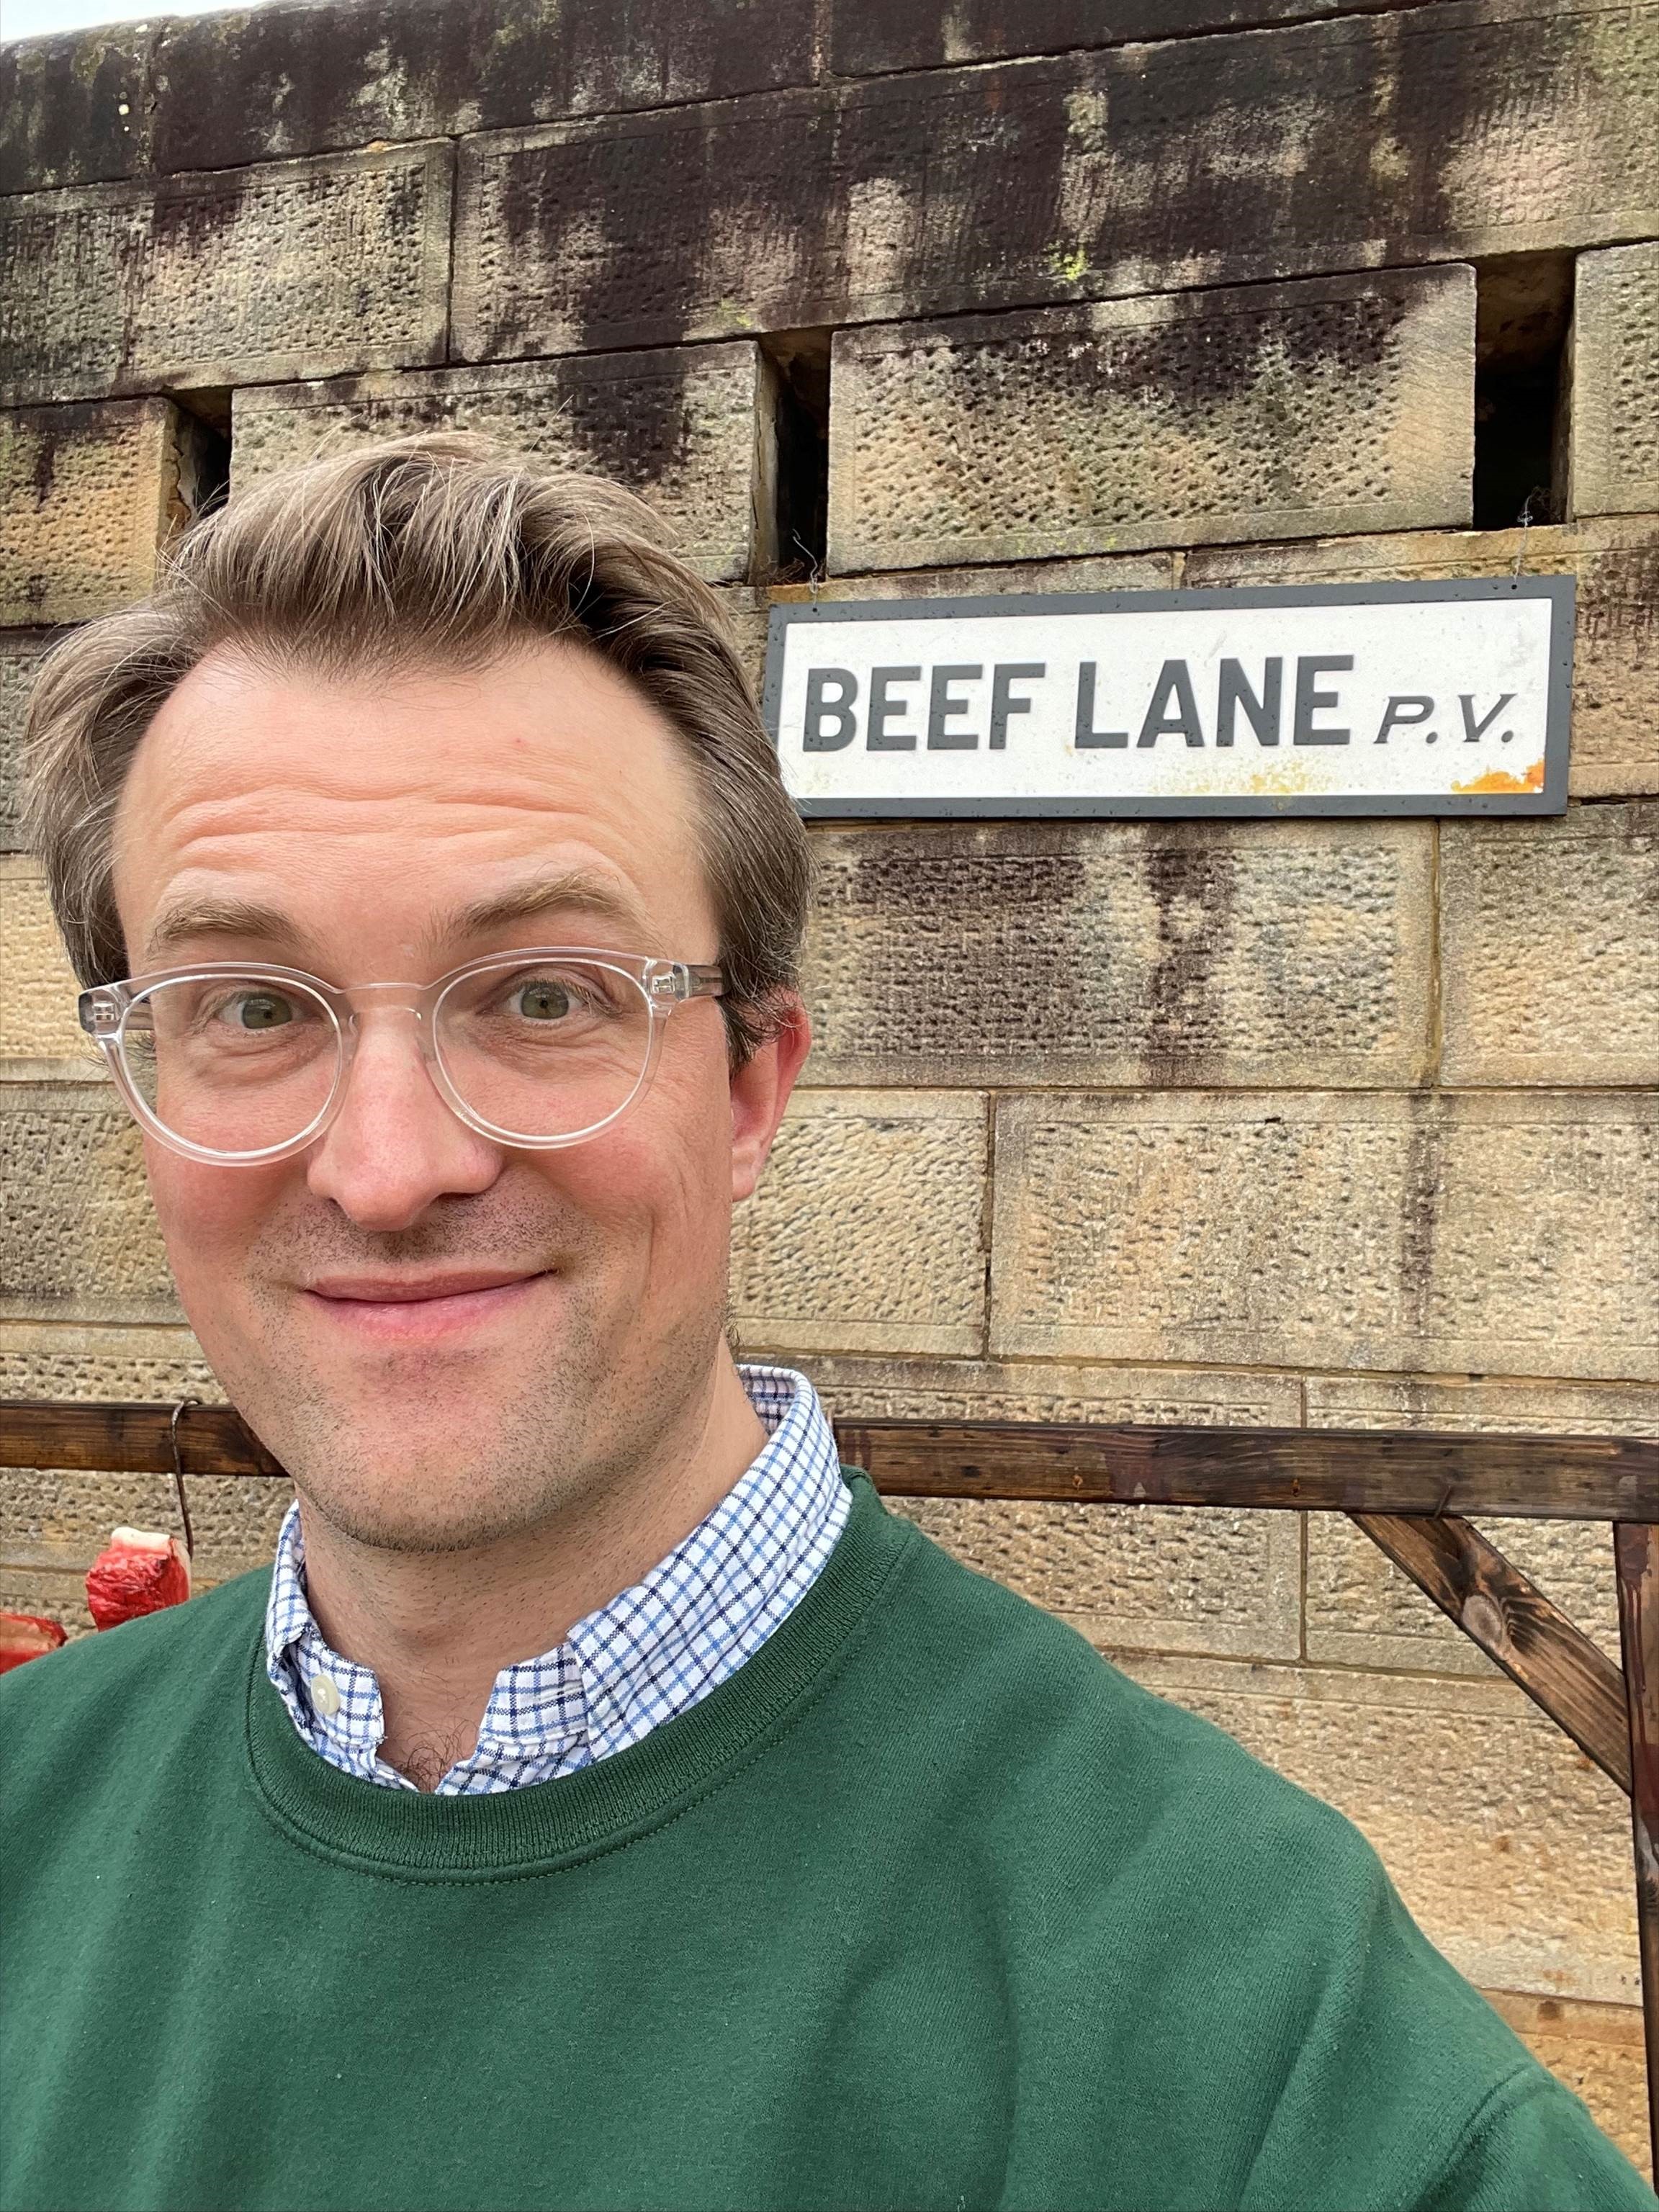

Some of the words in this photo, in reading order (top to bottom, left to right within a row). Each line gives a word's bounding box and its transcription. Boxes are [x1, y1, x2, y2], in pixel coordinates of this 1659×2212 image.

[801, 662, 1046, 752] BEEF
[1074, 655, 1354, 750] LANE
[1372, 693, 1517, 745] P.V.
